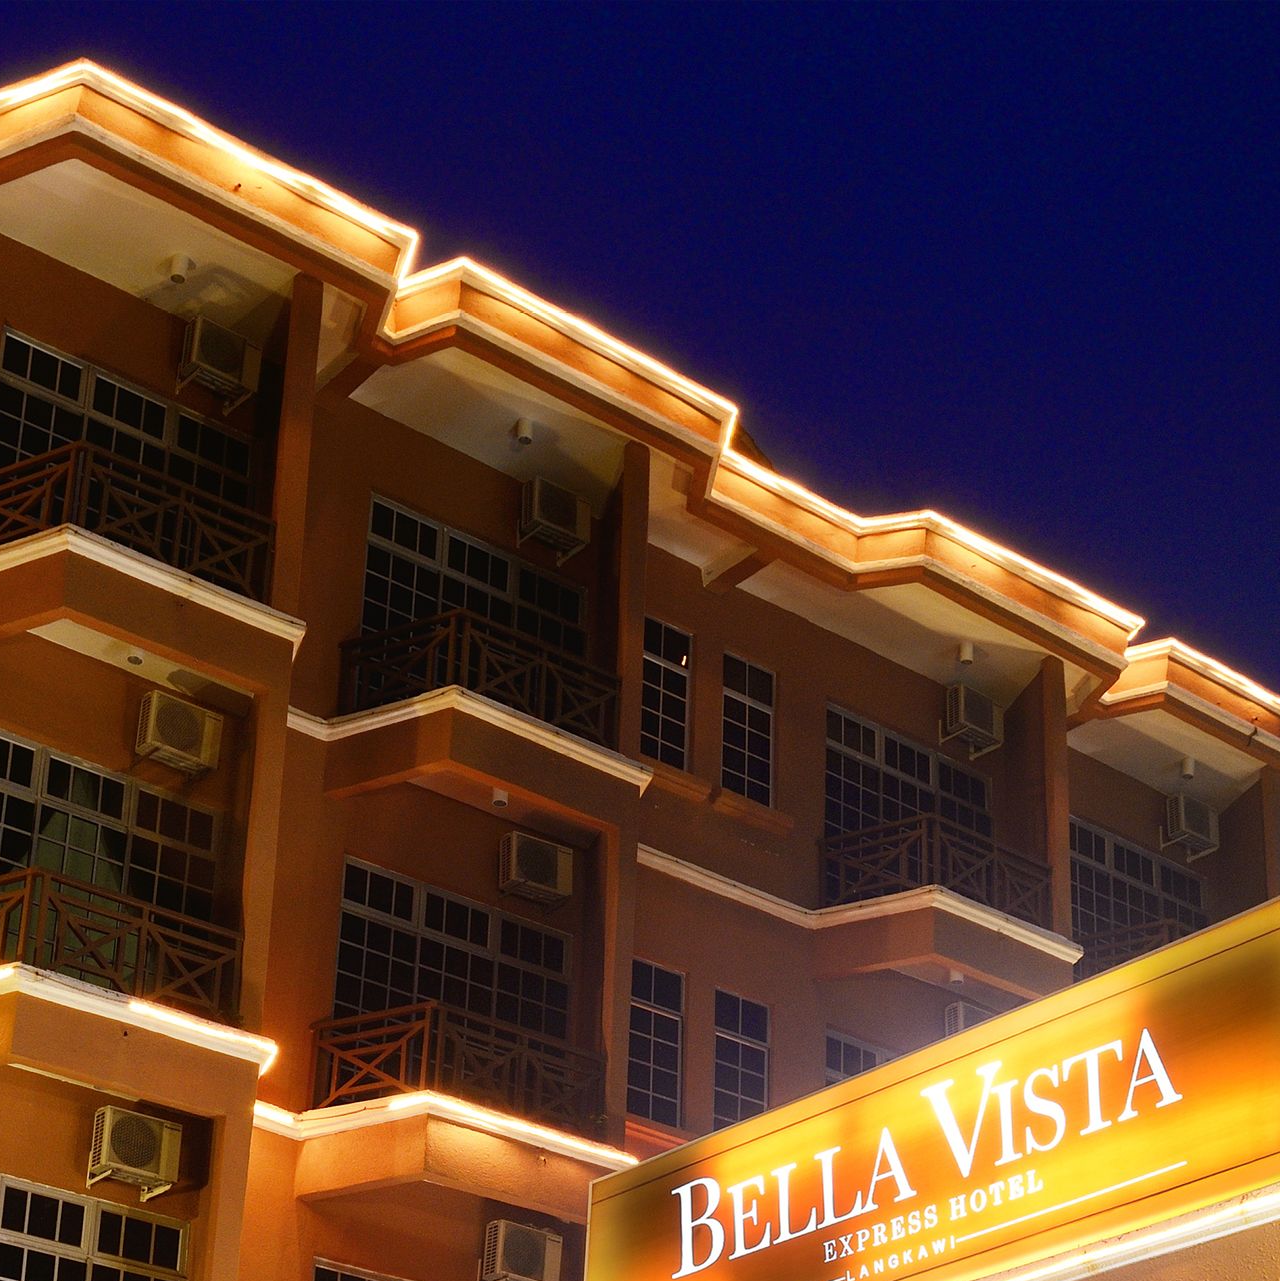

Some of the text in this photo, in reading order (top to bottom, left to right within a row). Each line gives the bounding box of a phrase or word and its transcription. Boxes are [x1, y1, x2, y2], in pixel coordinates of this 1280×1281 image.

[671, 1027, 1184, 1280] BELLA VISTA
[823, 1169, 1044, 1263] EXPRESS HOTEL
